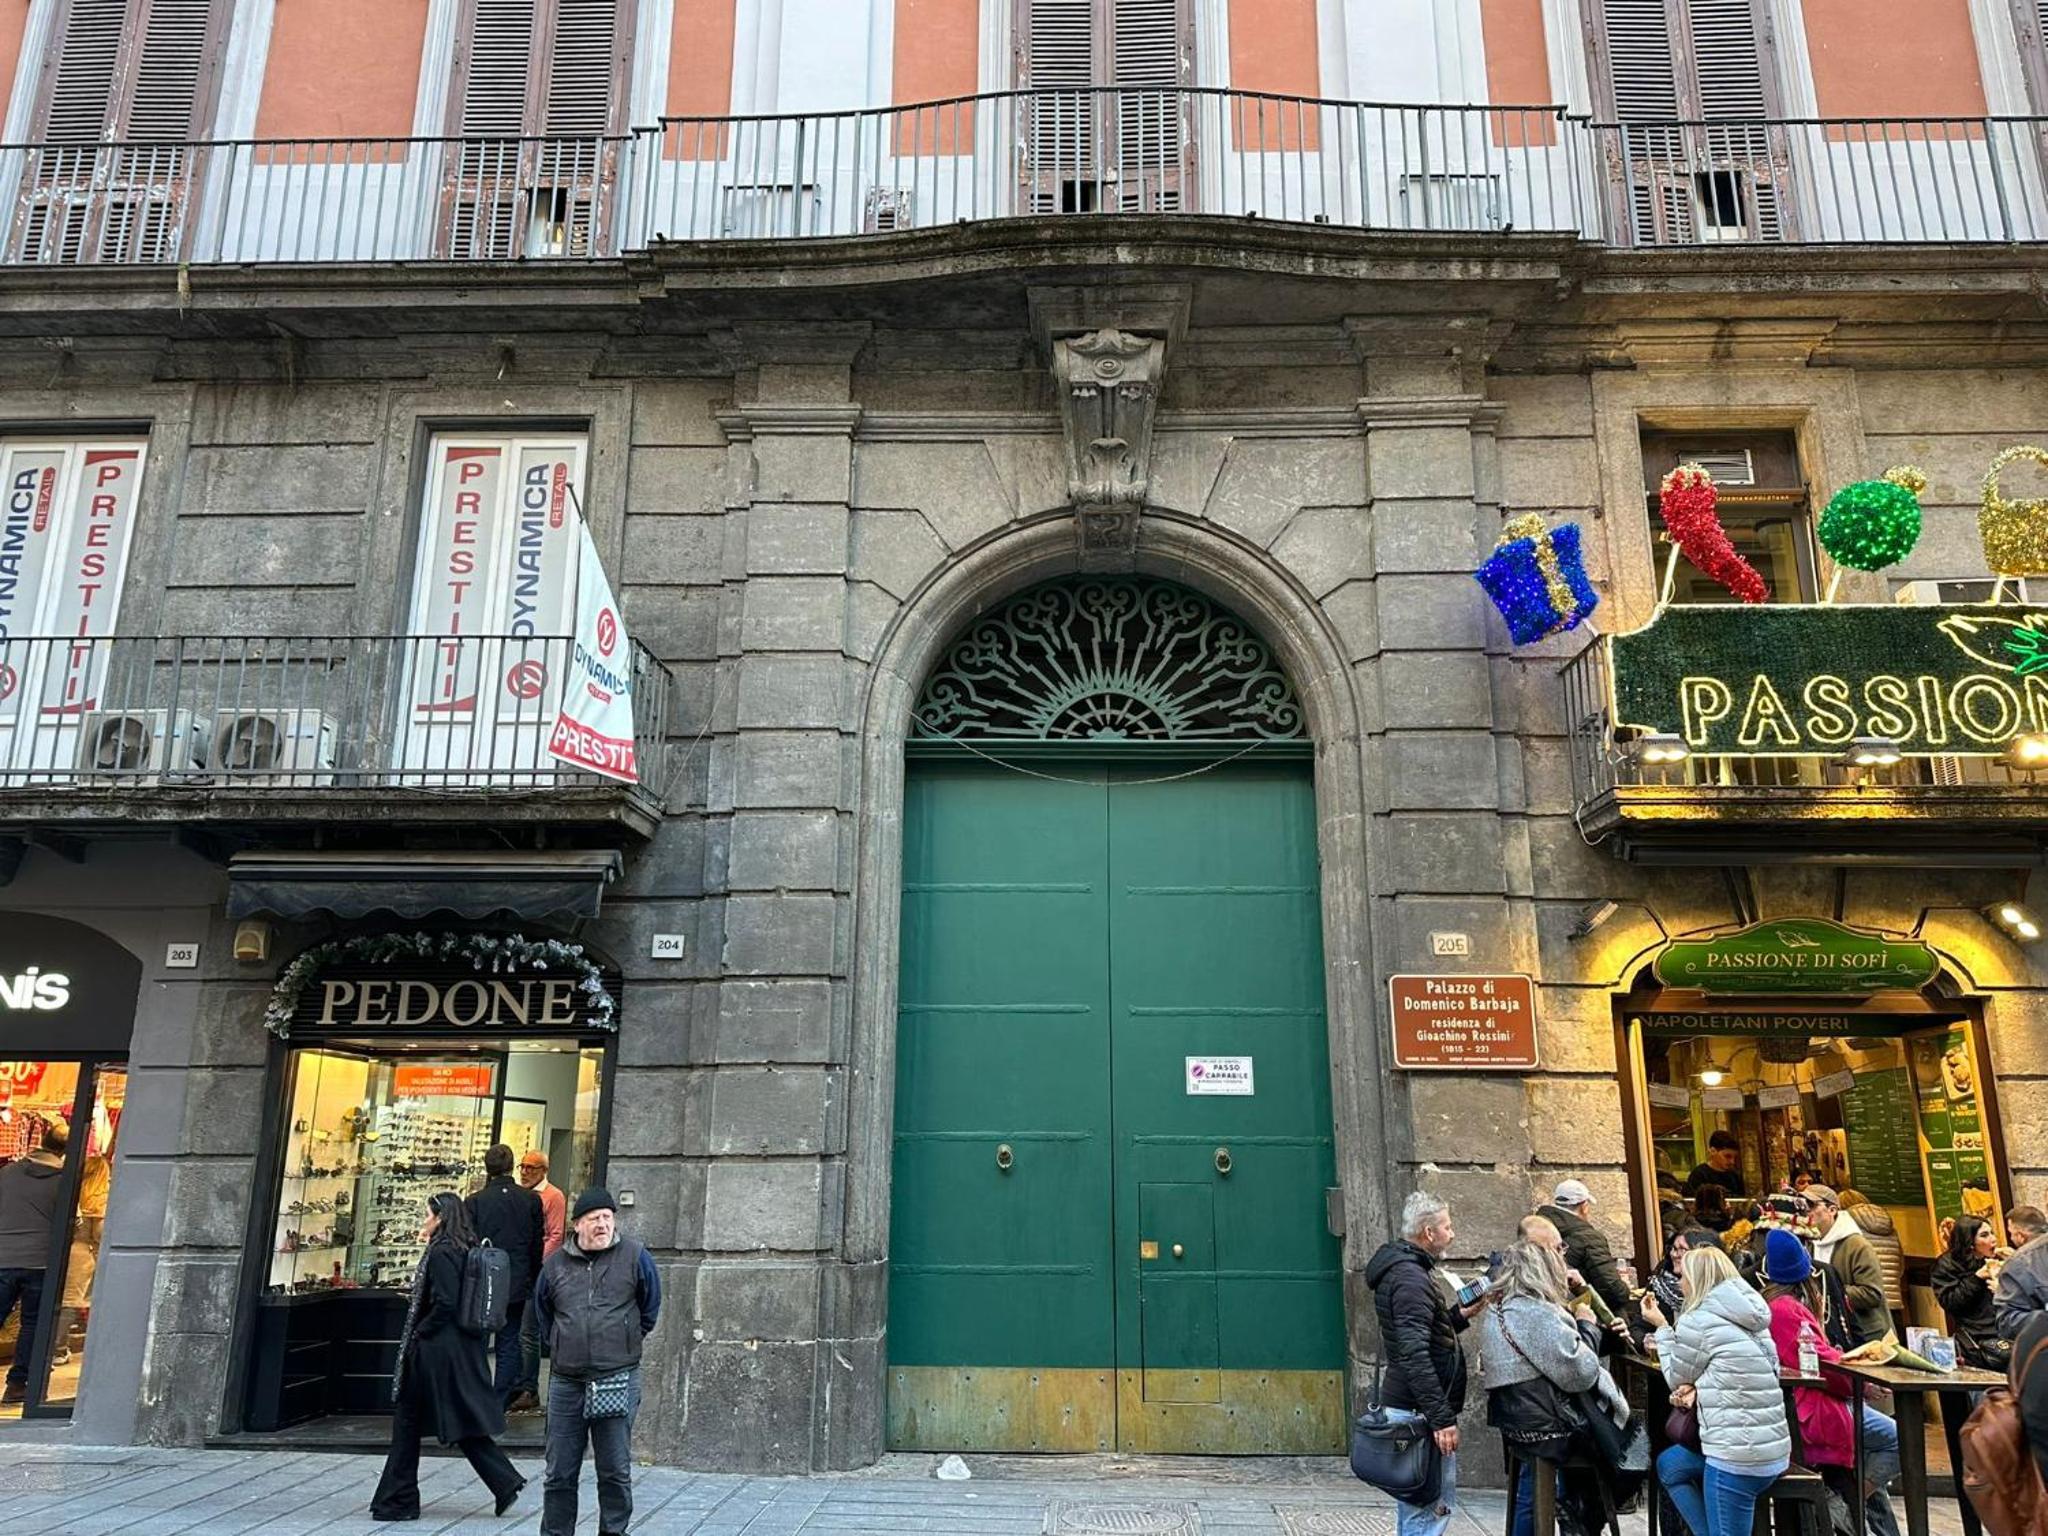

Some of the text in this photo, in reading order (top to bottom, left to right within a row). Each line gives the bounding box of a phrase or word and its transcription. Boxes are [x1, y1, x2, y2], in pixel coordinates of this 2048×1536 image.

[36, 473, 55, 528] RETAIL
[551, 468, 567, 522] RETAIL
[512, 463, 549, 641] DYNAMICA
[67, 466, 121, 699] PRESTITI
[441, 463, 485, 697] PRESTITI
[657, 939, 680, 950] 204
[171, 950, 192, 961] 203
[1707, 951, 1888, 969] PASSIONE DI SOFÌ
[1426, 980, 1495, 994] Palazzo di
[315, 980, 578, 1026] PEDONE
[1404, 997, 1520, 1013] Domenico Barbaja
[1431, 1017, 1495, 1028] residenza di
[1640, 1015, 1849, 1030] NAPOLETANI POVERI
[1416, 1030, 1510, 1041] Gioachino Rossini
